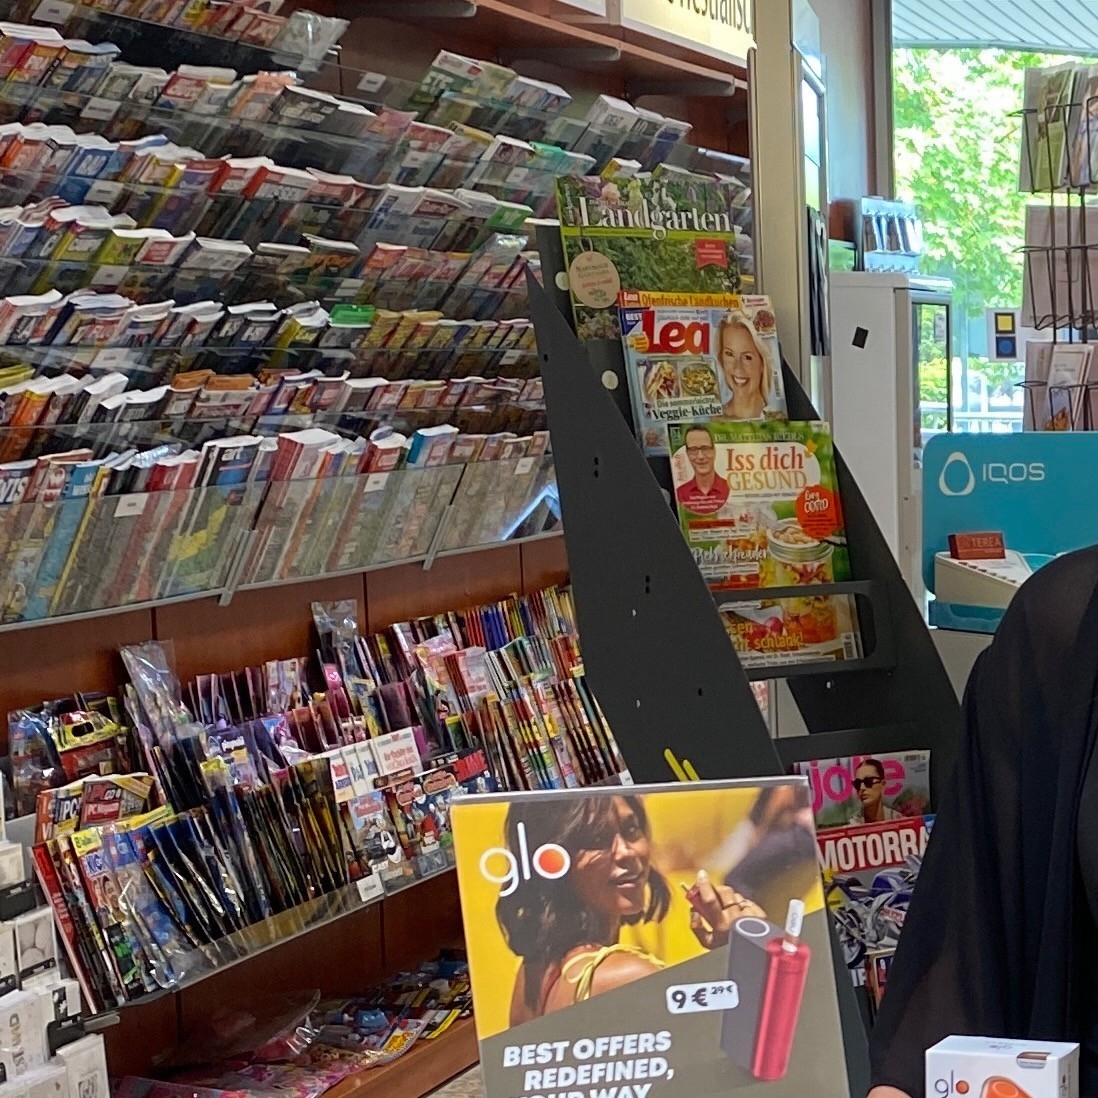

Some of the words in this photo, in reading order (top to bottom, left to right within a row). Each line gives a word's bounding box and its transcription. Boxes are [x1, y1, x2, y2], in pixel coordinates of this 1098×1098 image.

[579, 197, 731, 240] Landgarten
[642, 309, 710, 355] Lea
[652, 404, 722, 420] Veggie-Küche
[726, 448, 755, 471] Iss
[760, 446, 804, 470] dich
[982, 463, 1046, 484] IQOS
[727, 471, 808, 490] GESUND
[810, 755, 906, 815] jole
[478, 822, 571, 897] glo
[503, 1040, 570, 1068] BEST
[571, 1030, 672, 1060] OFFERS
[524, 1057, 674, 1092] REDEFINED,
